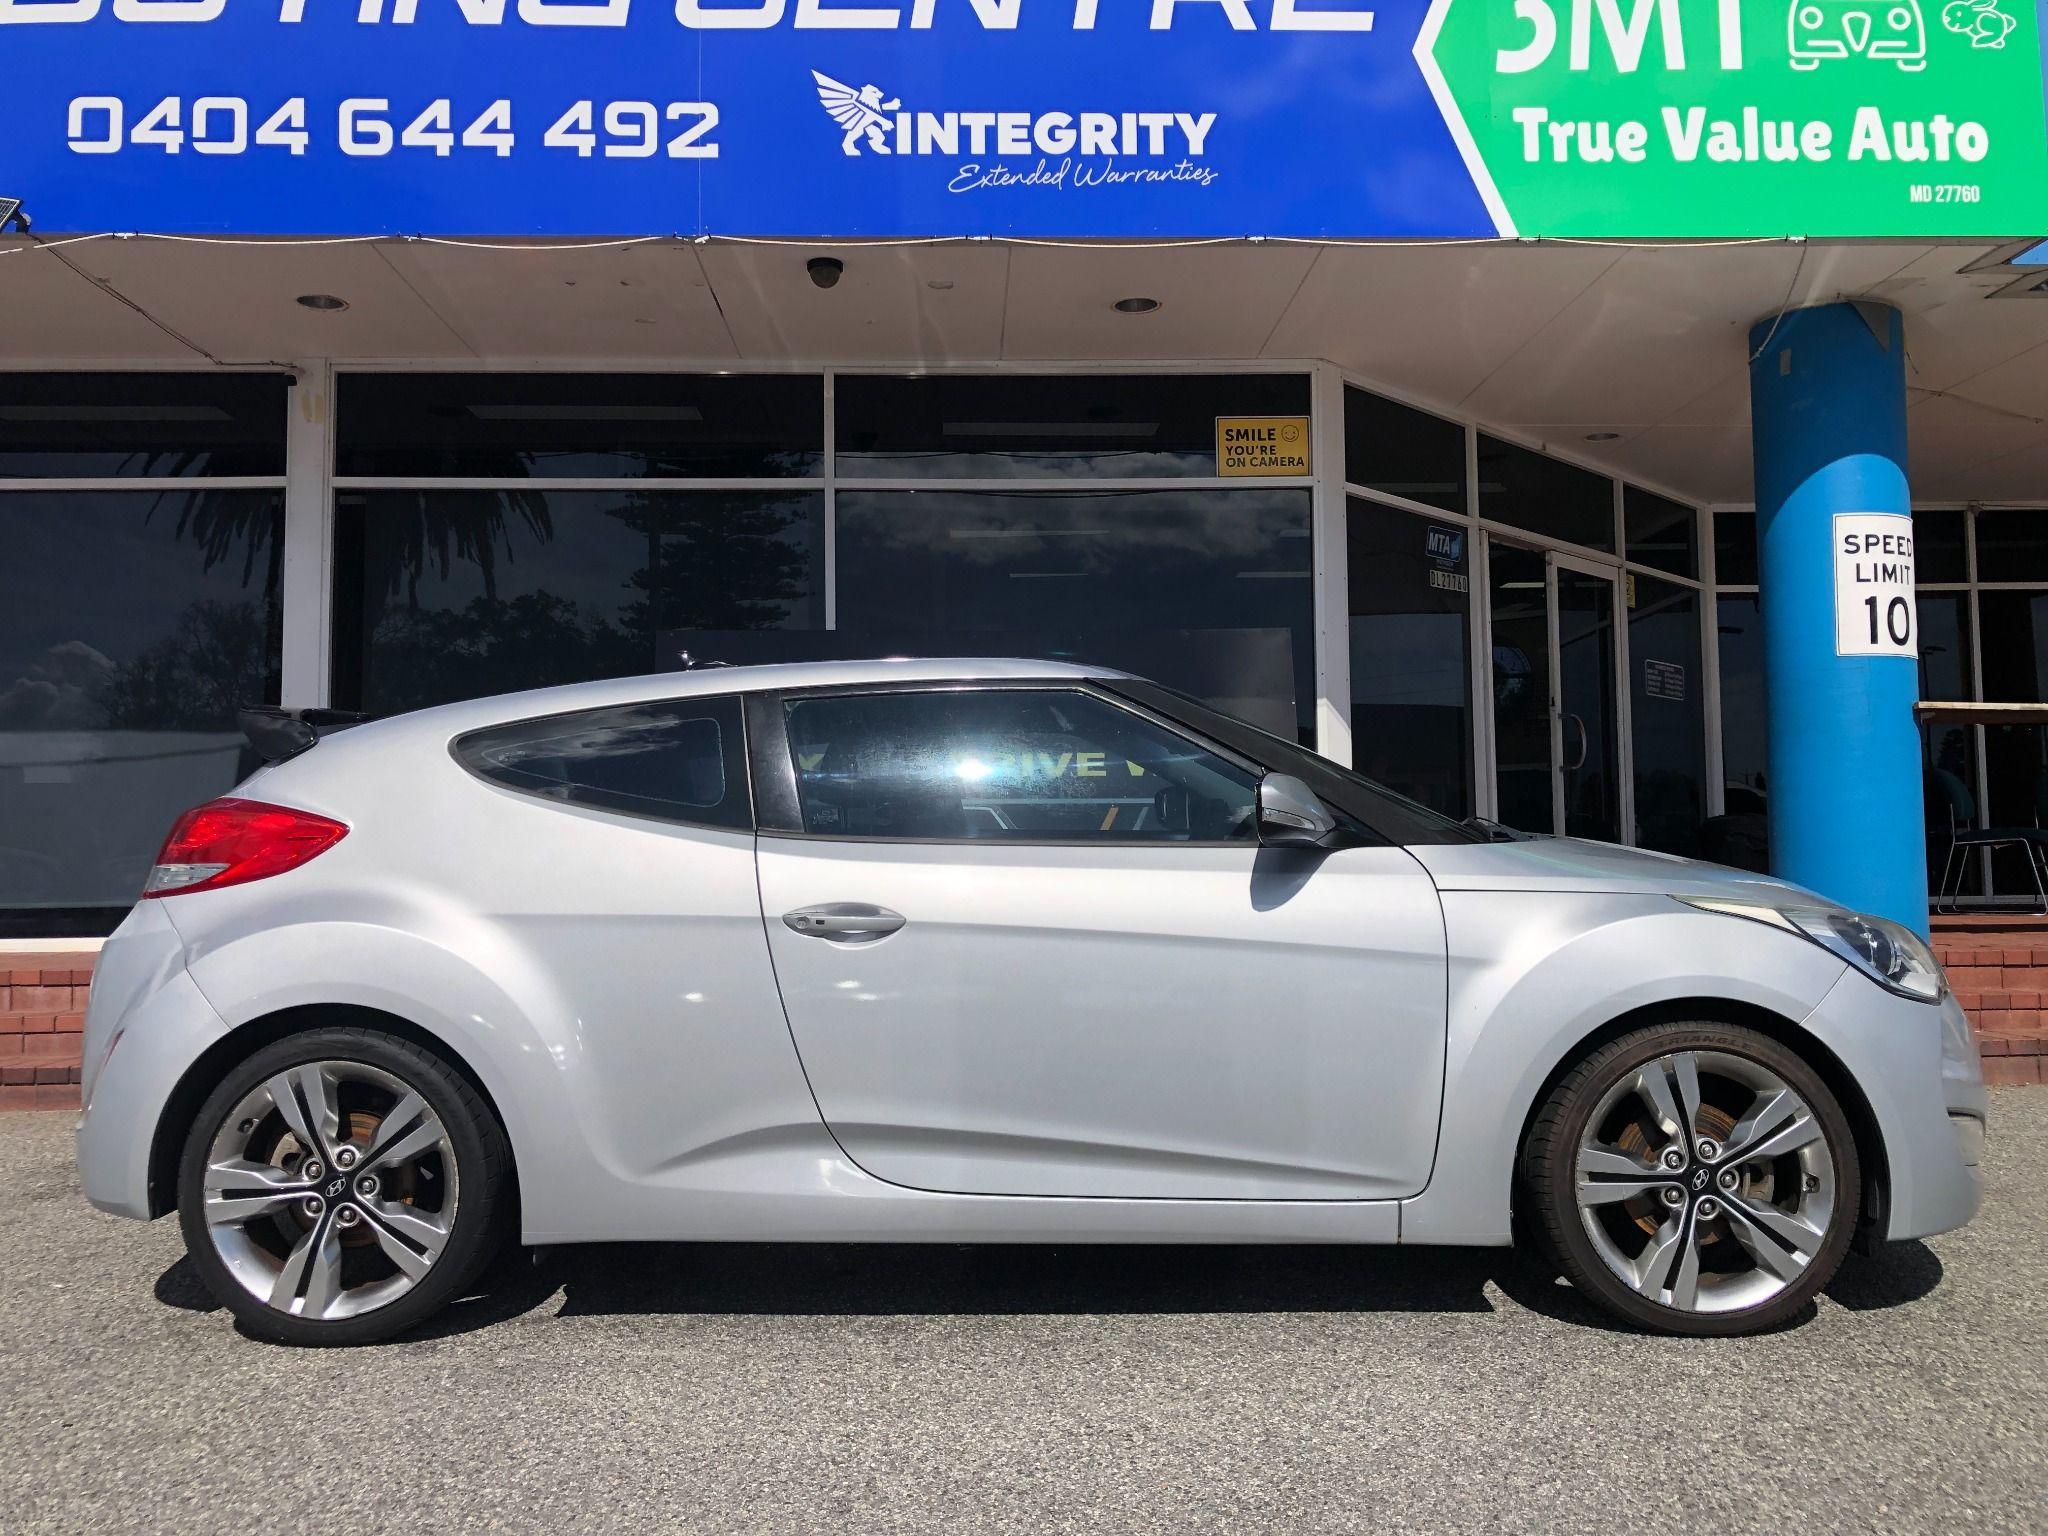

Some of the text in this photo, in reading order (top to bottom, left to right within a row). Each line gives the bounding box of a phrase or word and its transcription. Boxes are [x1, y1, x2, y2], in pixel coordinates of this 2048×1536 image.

[67, 96, 719, 159] 0404 644 492
[896, 112, 1218, 155] INTEGRITY
[1513, 106, 1989, 163] True Value Auto
[948, 157, 1218, 193] Extended Warranties
[1910, 185, 1980, 203] MD 27760
[1225, 428, 1277, 442] SMILE
[1226, 445, 1277, 456] YOU'RE
[1226, 456, 1305, 468] ON CAMERA
[1429, 532, 1451, 554] MTA
[1843, 534, 1912, 557] SPEED
[1856, 563, 1910, 585] LIMIT
[1864, 596, 1910, 646] 10
